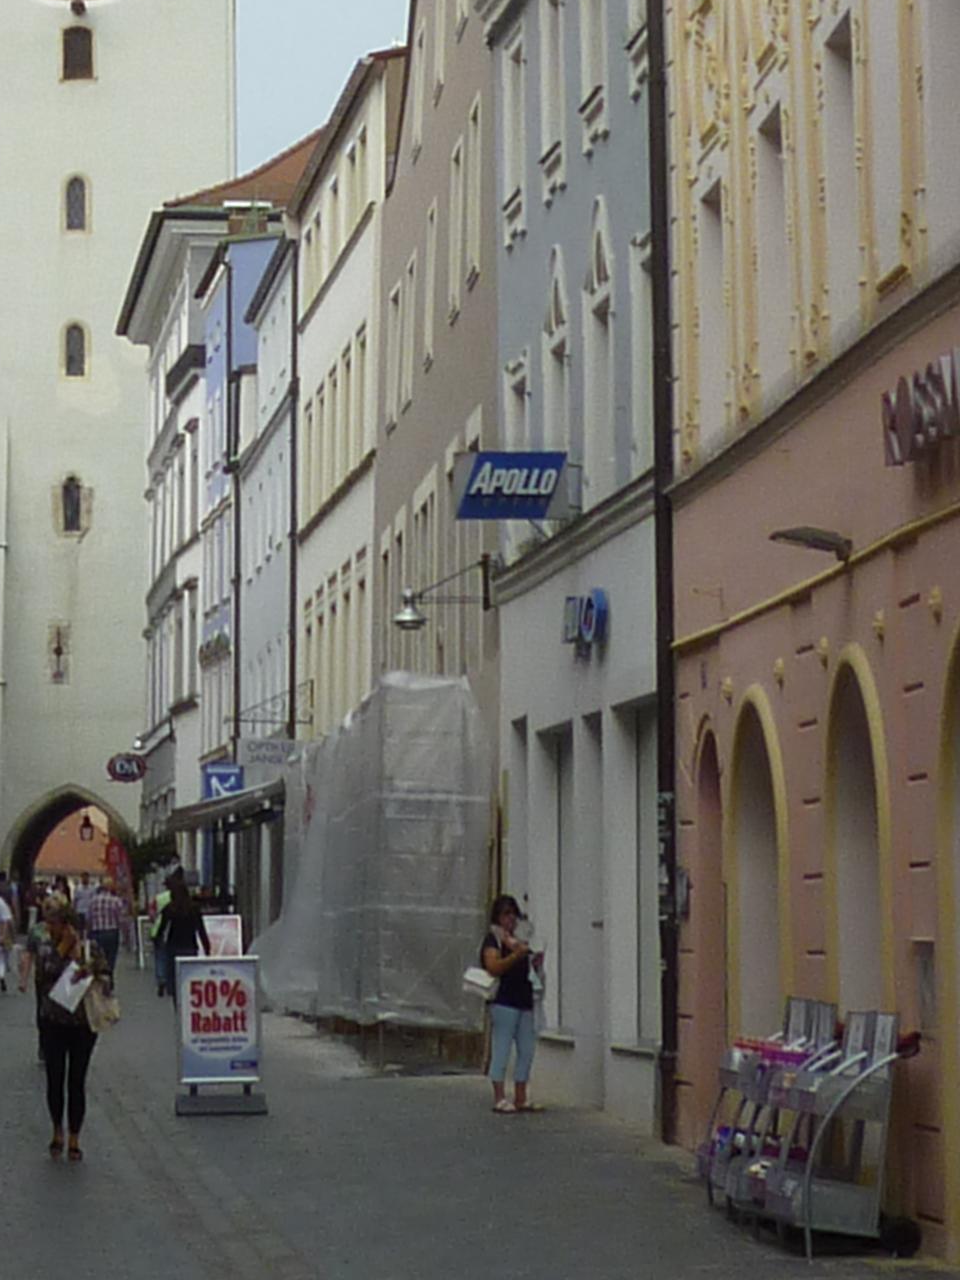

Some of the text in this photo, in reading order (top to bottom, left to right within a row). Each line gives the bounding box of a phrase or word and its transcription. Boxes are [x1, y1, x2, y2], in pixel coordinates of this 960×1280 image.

[468, 461, 558, 496] APOLLO
[190, 980, 247, 1008] 50%
[191, 1010, 248, 1034] Rabatt
